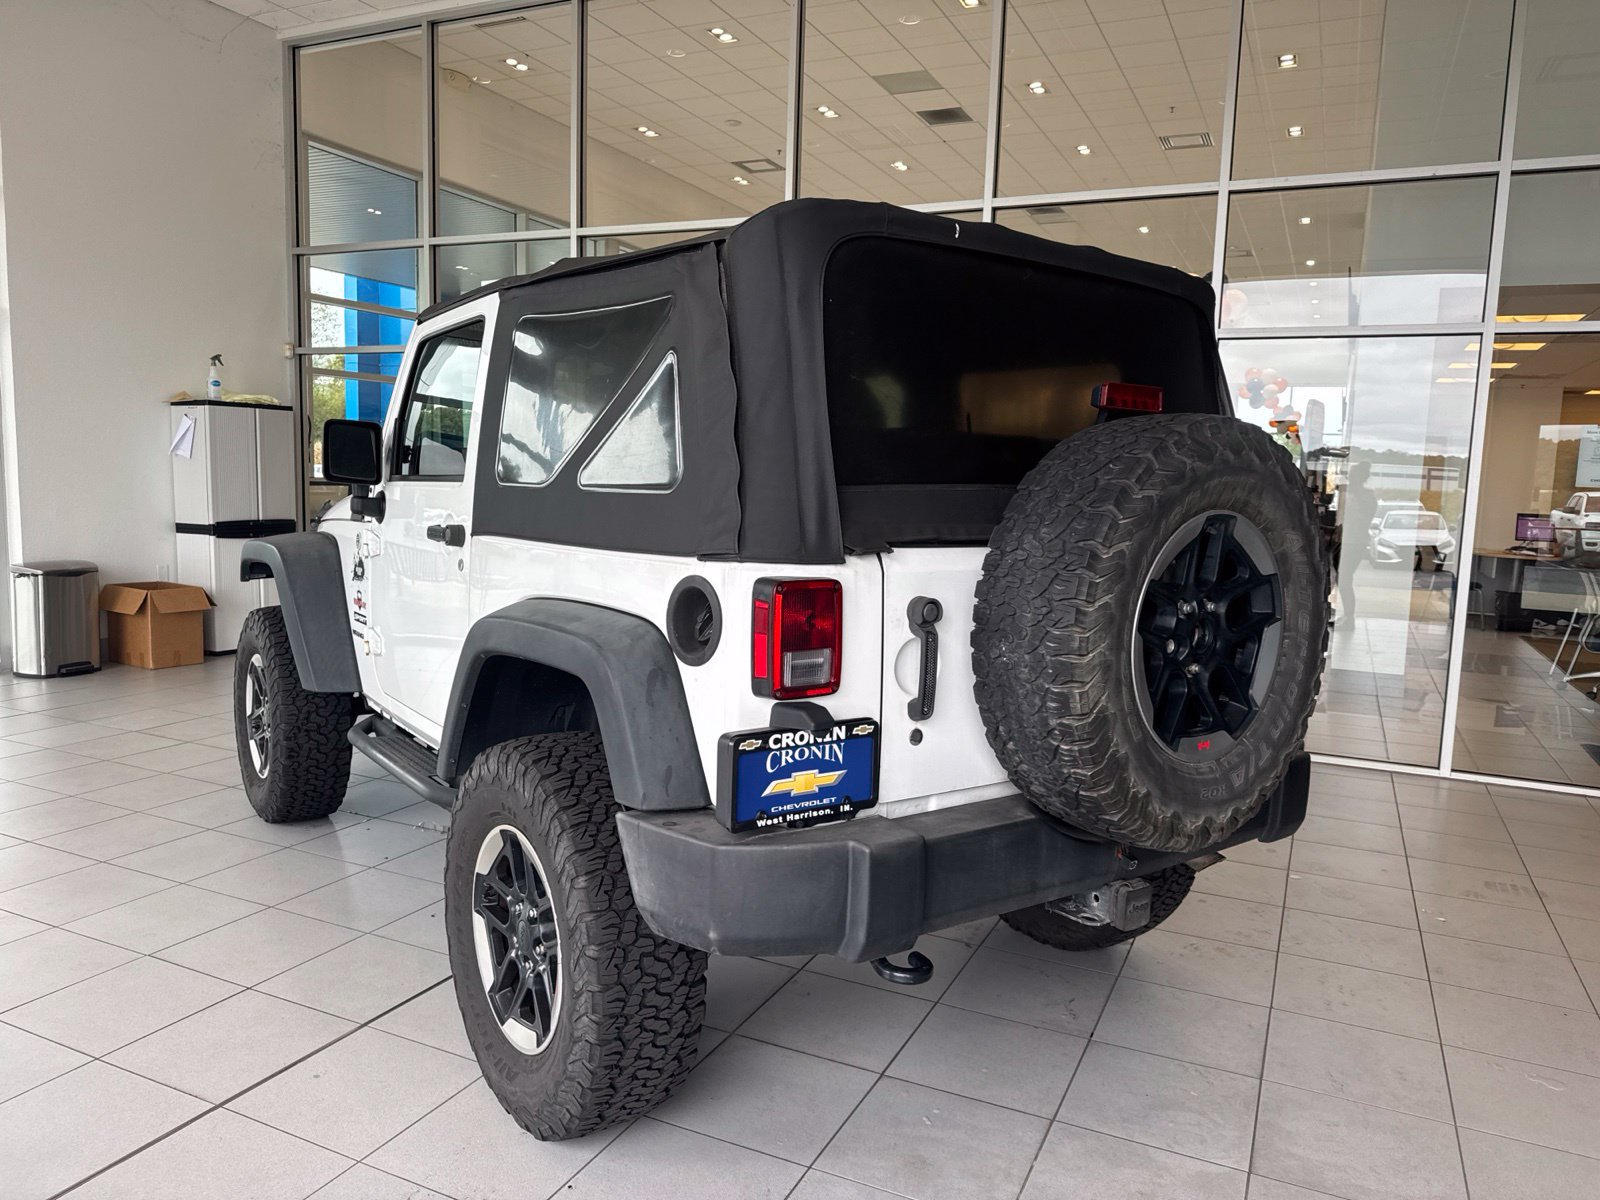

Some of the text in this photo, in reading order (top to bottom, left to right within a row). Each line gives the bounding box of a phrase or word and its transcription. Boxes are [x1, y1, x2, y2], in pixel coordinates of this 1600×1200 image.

[766, 743, 845, 773] CRONIN
[771, 797, 837, 812] CHEVROLET
[756, 816, 783, 828] West
[1128, 902, 1149, 914] Jeep
